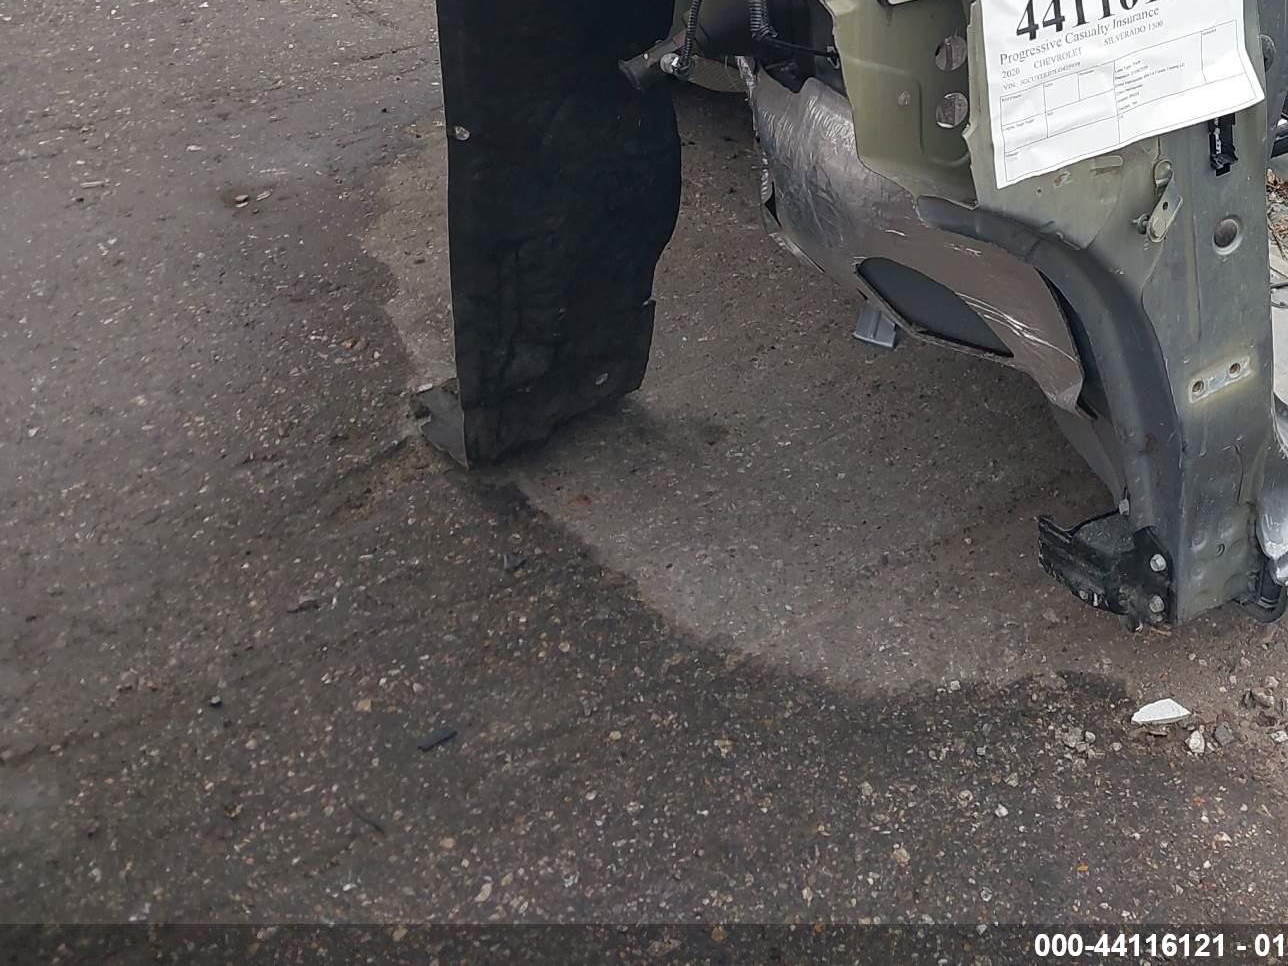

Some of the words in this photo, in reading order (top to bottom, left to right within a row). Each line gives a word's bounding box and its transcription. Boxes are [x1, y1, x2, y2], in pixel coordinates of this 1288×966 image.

[1000, 36, 1062, 65] Progressive
[1065, 22, 1110, 44] Casualty
[1112, 7, 1160, 29] Insurance
[1002, 67, 1020, 79] 2020
[1033, 47, 1082, 69] CHEVROLET
[1103, 25, 1146, 46] SILVERADO
